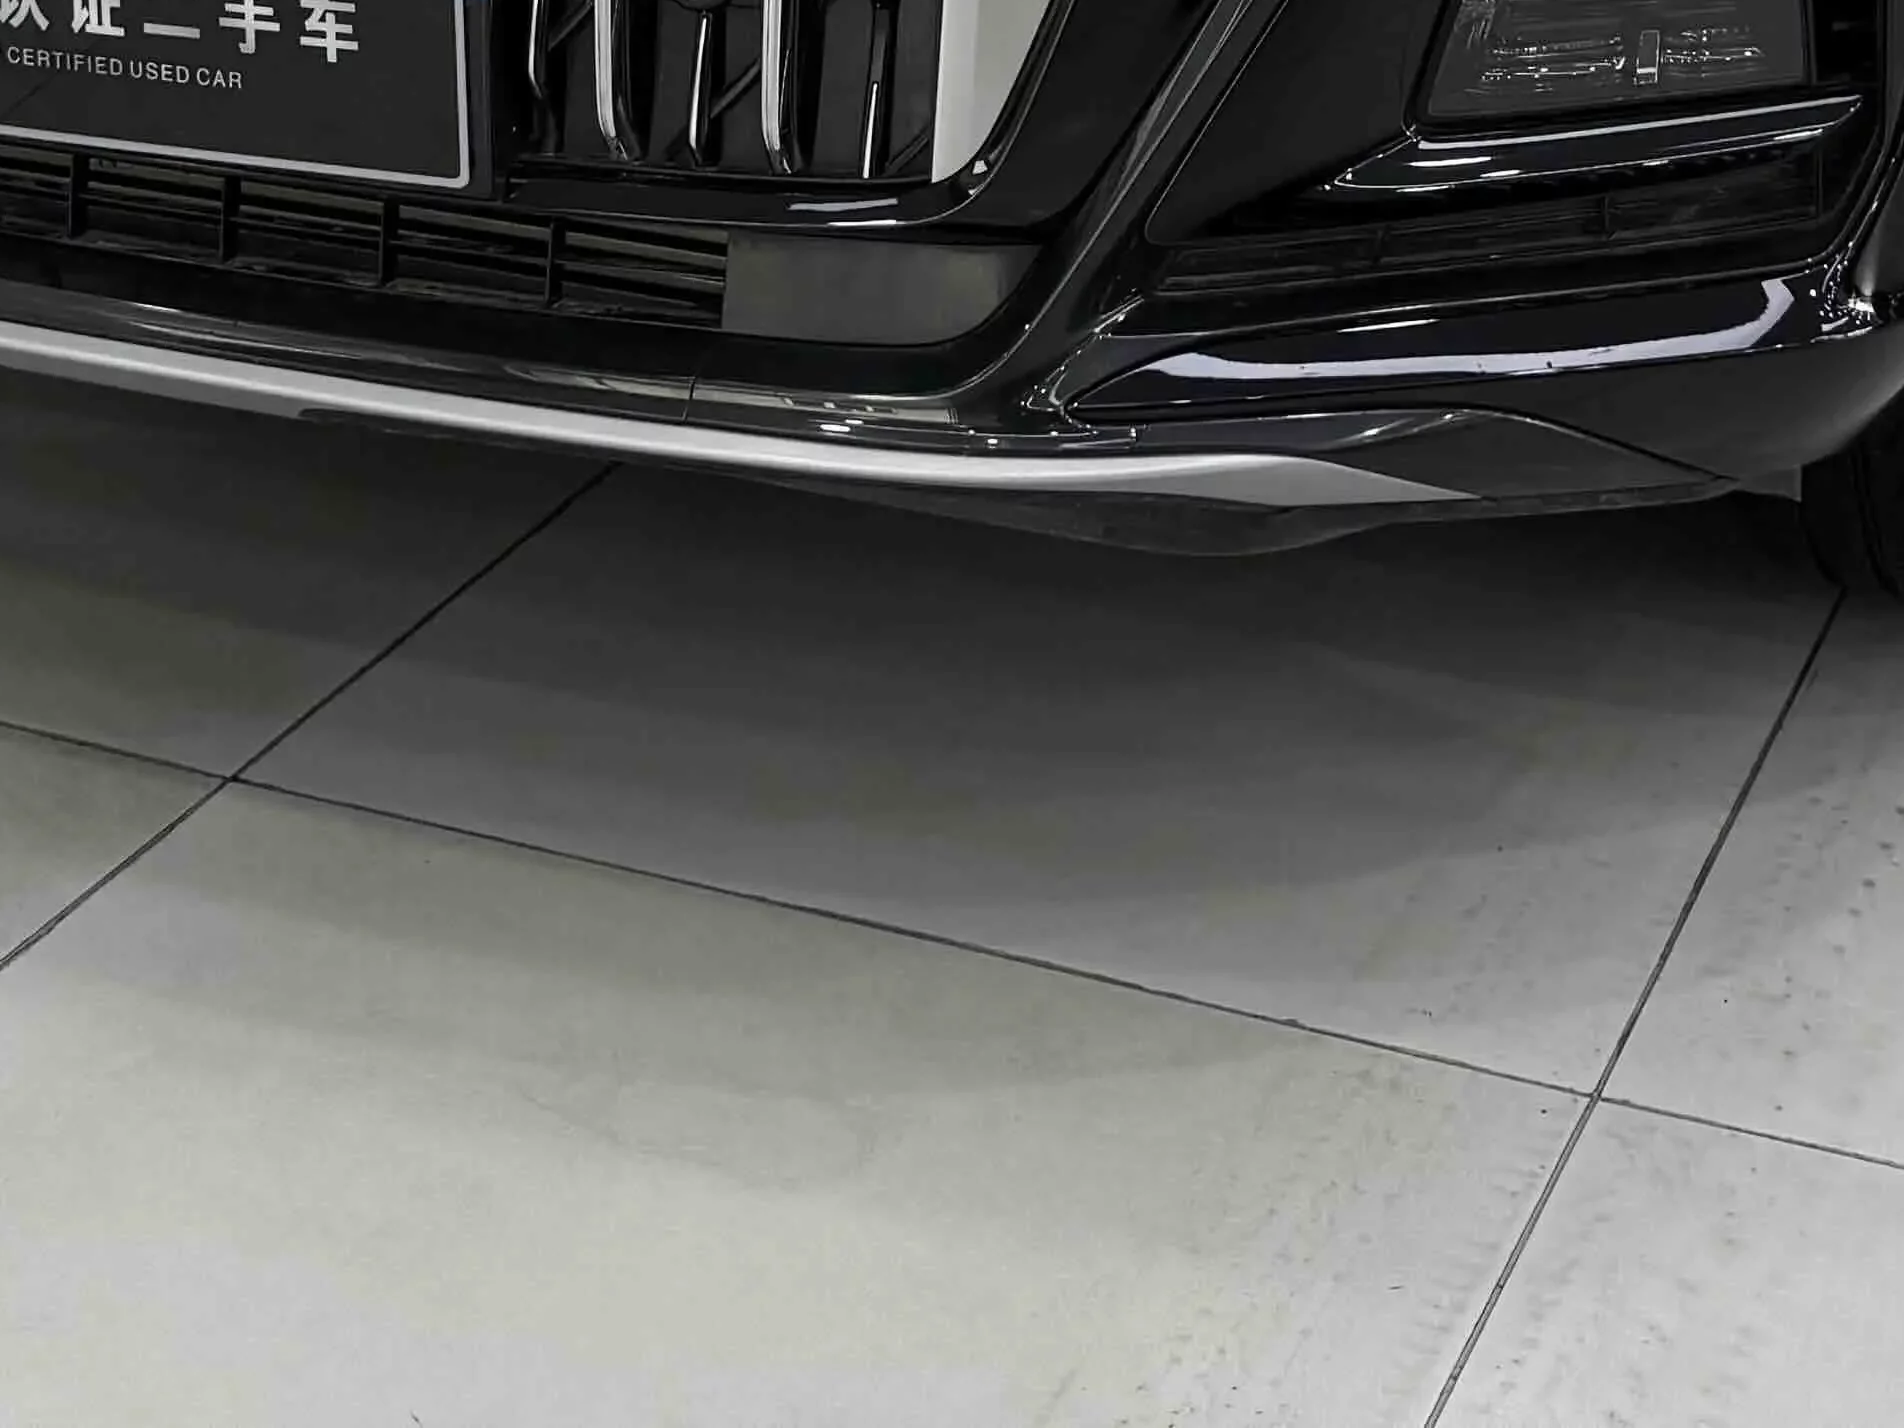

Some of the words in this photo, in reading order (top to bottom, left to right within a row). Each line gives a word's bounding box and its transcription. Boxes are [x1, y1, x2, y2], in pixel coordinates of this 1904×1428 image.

[7, 47, 124, 78] CERTIFIED
[129, 58, 191, 86] USED
[195, 66, 244, 90] CAR
